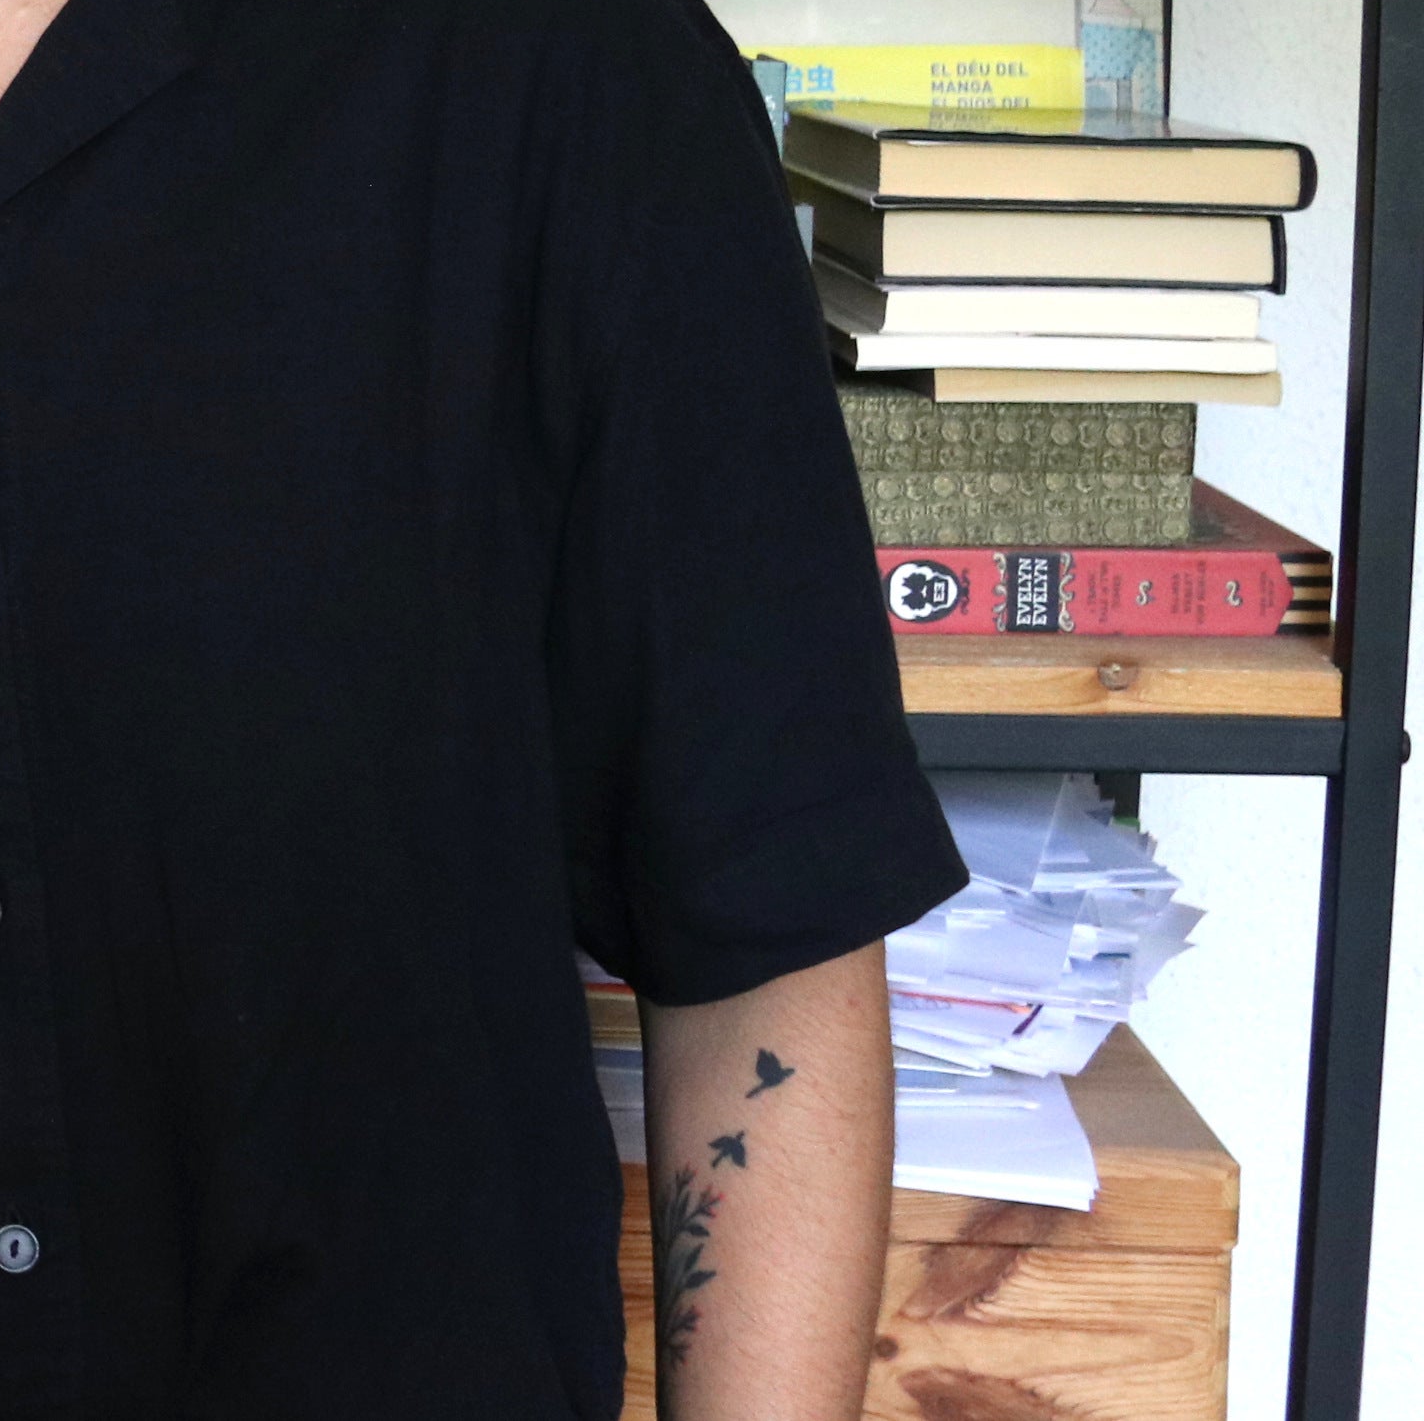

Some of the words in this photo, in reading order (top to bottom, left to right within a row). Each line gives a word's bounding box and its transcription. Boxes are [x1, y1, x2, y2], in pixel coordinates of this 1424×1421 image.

[931, 63, 951, 77] EL
[957, 59, 991, 77] DÉU
[997, 63, 1029, 77] DEL
[931, 80, 993, 93] MANGA
[1016, 557, 1033, 626] EVELYN
[1032, 557, 1049, 626] EVELYN
